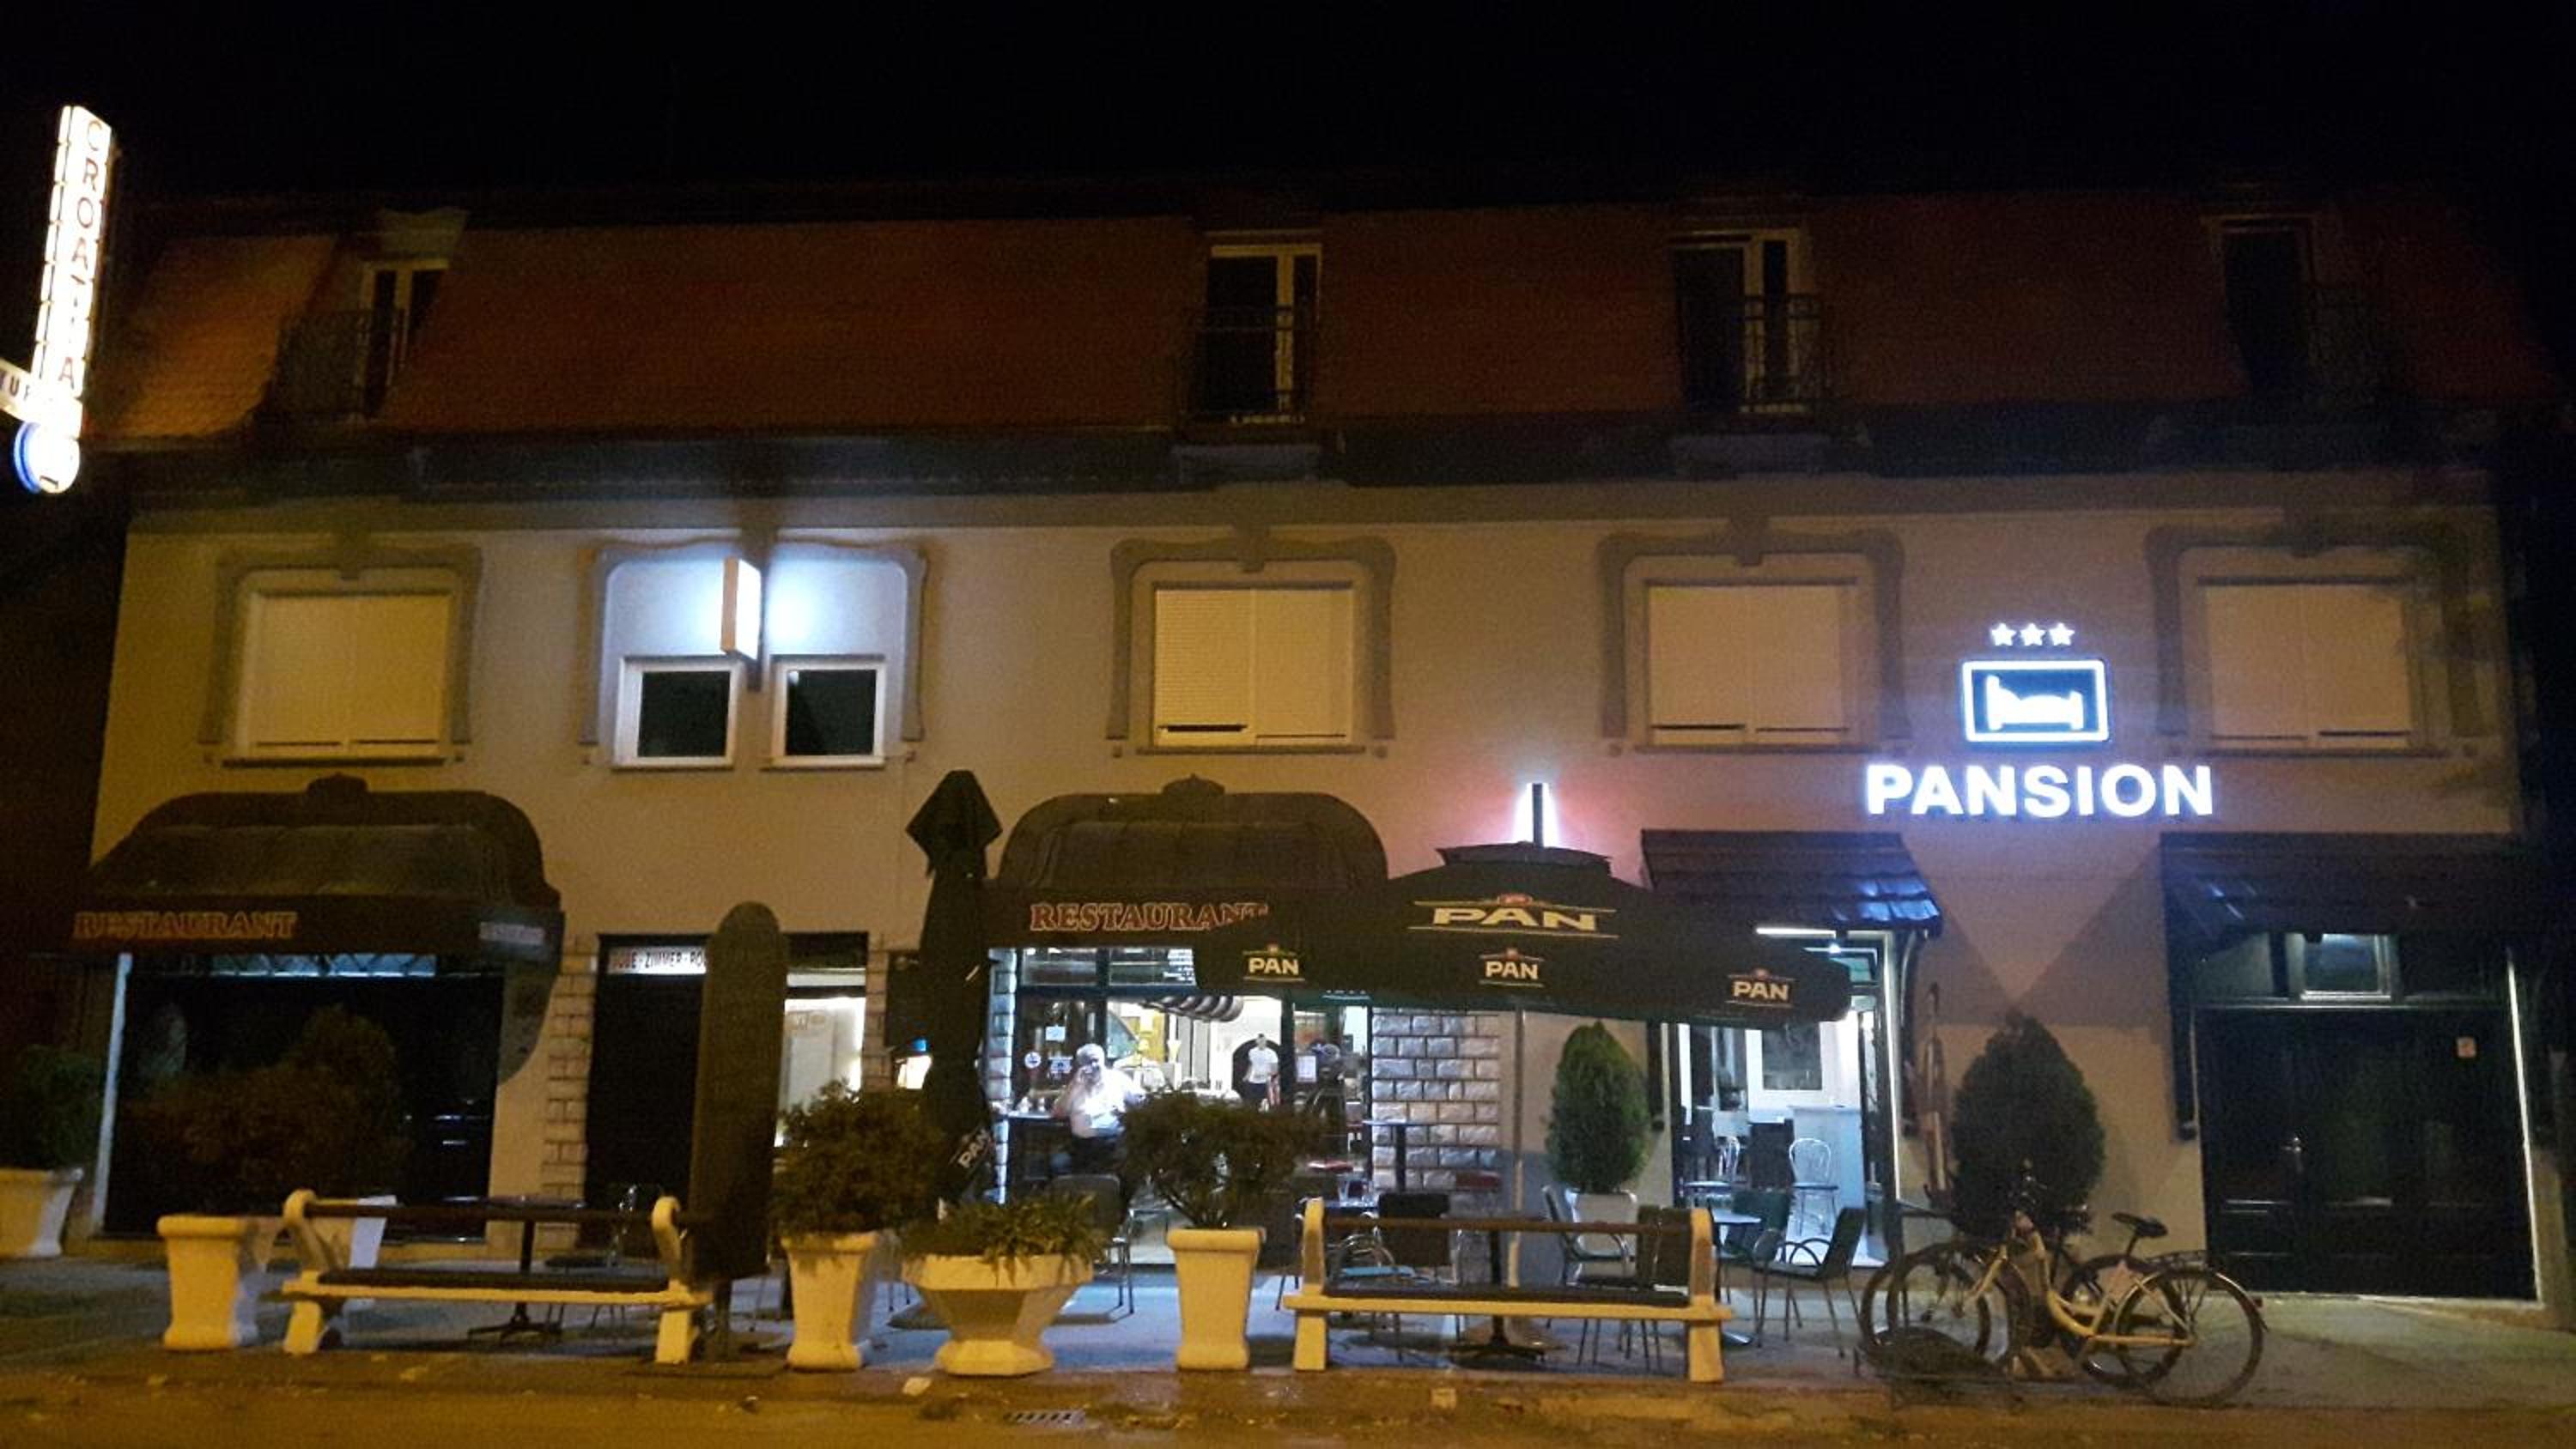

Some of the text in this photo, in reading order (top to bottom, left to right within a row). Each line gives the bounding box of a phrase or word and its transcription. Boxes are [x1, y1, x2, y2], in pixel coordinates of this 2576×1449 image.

[1866, 764, 2213, 817] PANSION
[72, 911, 298, 939] RESTAURANT
[1433, 906, 1596, 931] PAN
[1249, 957, 1299, 975] PAN
[1485, 961, 1539, 980] PAN
[1731, 981, 1789, 1001] PAN
